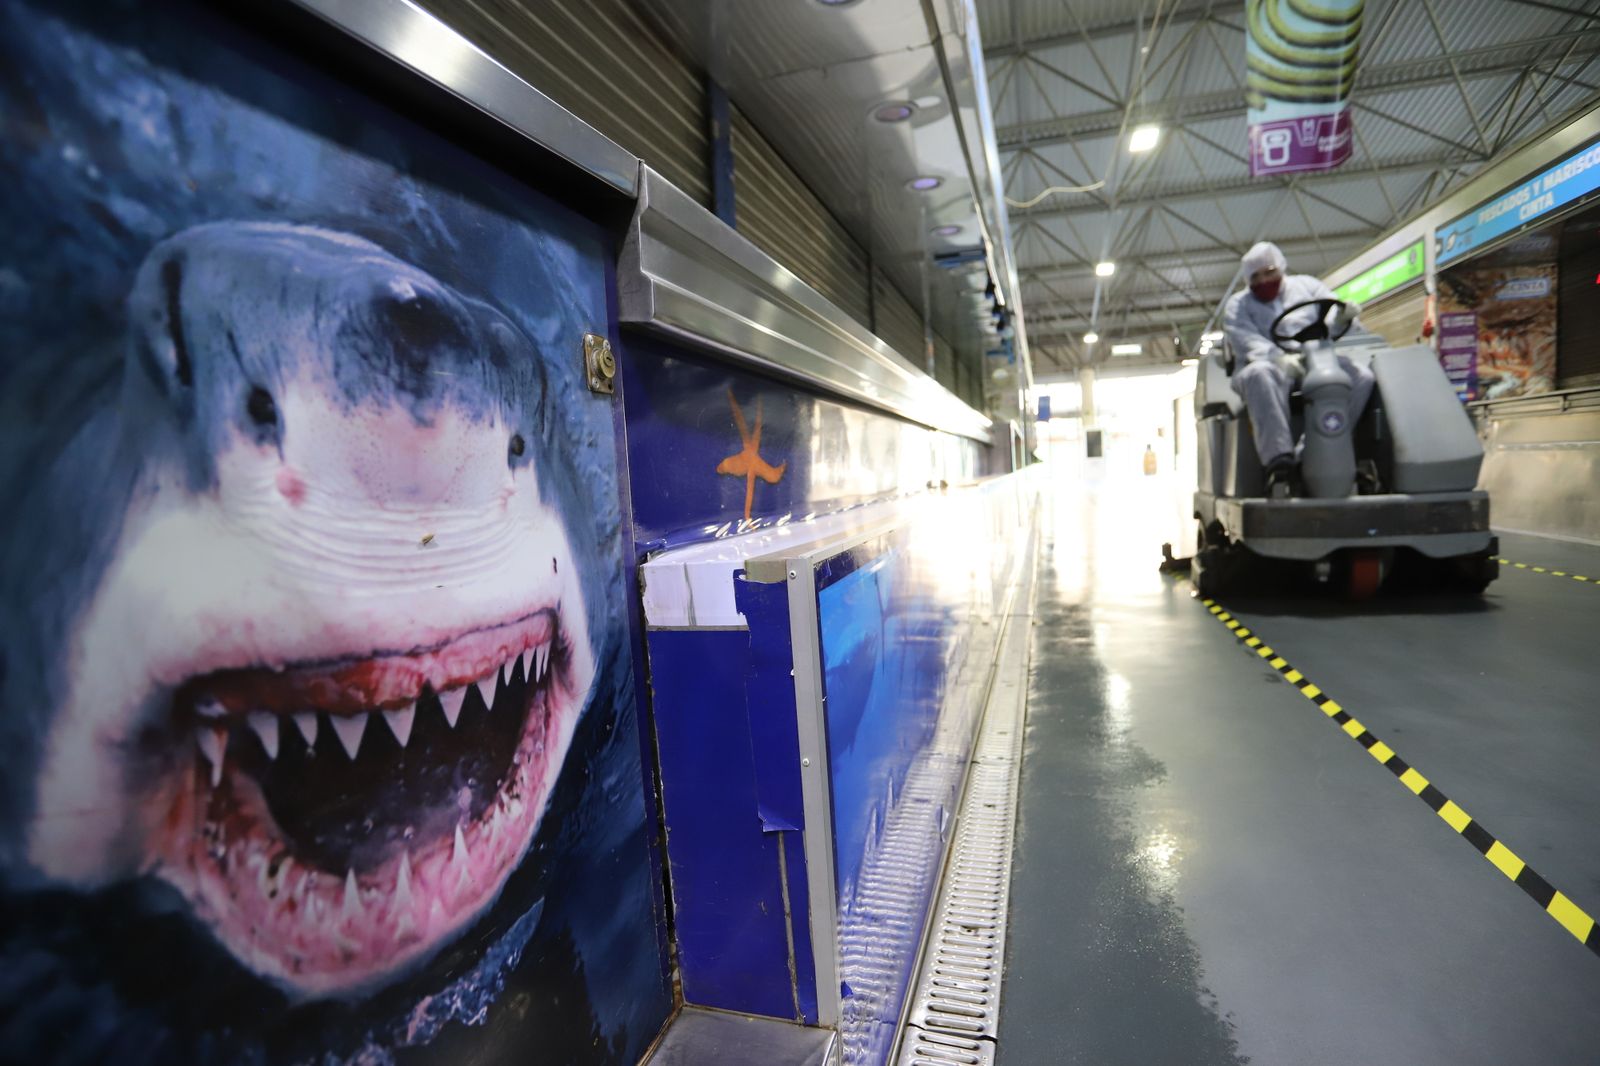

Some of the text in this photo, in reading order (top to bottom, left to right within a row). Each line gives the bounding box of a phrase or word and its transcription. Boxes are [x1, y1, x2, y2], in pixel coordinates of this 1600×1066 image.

[1478, 186, 1531, 224] PESCADOS
[1533, 179, 1541, 196] Y
[1519, 192, 1554, 220] CINTA
